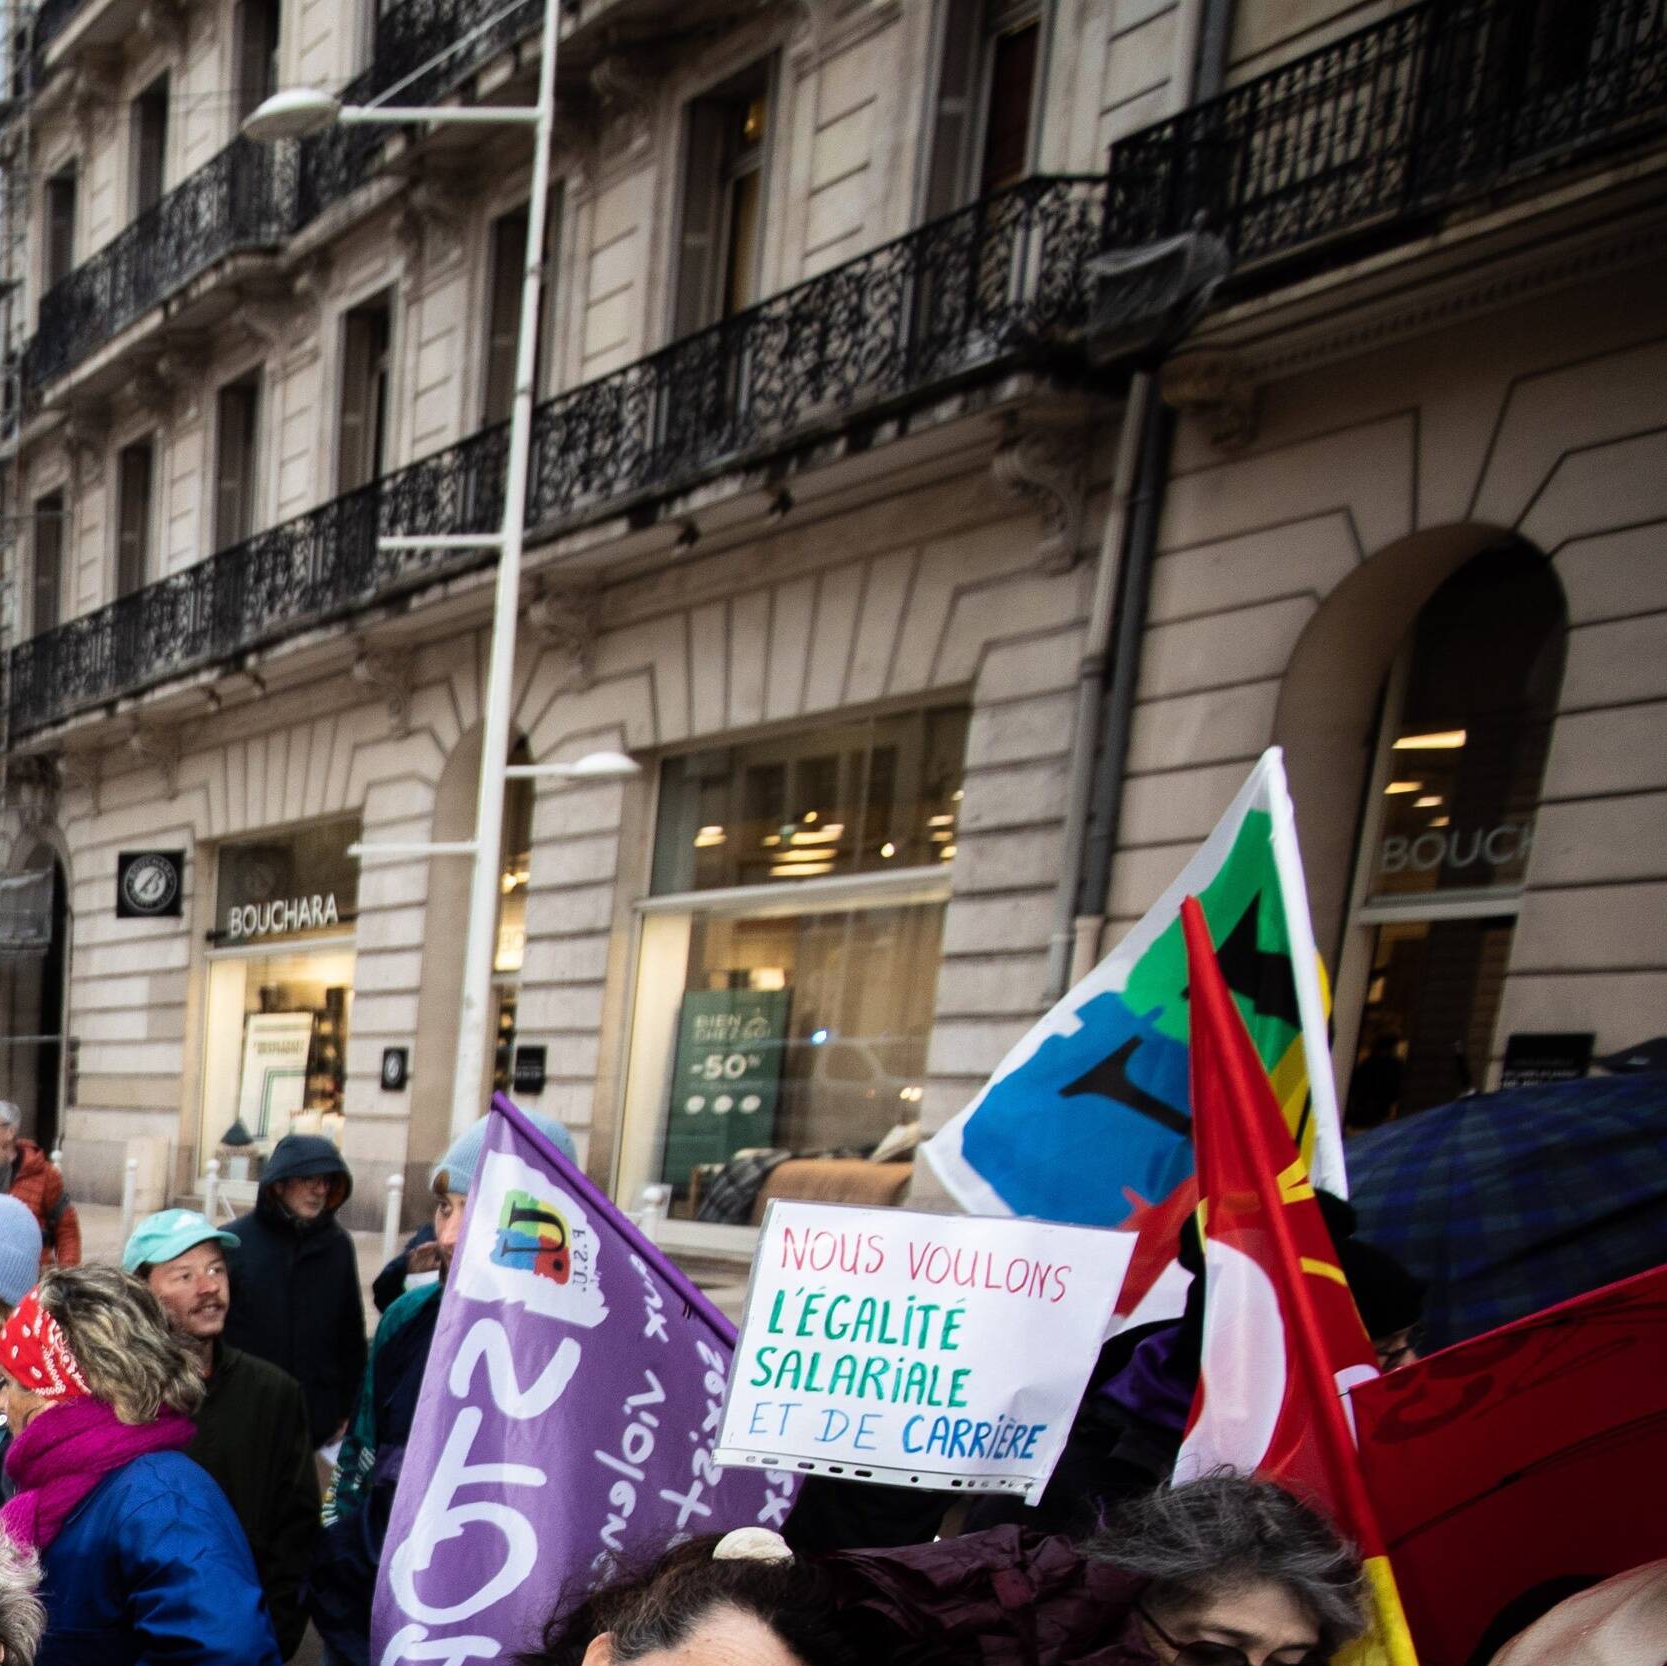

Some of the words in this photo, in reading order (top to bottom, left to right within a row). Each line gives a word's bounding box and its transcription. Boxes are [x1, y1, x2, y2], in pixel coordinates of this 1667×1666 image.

[229, 892, 339, 939] BOUCHARA
[780, 1226, 885, 1276] NOUS
[909, 1240, 1073, 1304] VOULONS
[748, 1401, 803, 1437] ET
[814, 1408, 884, 1451] DE
[901, 1413, 1048, 1460] CARRIÈRE
